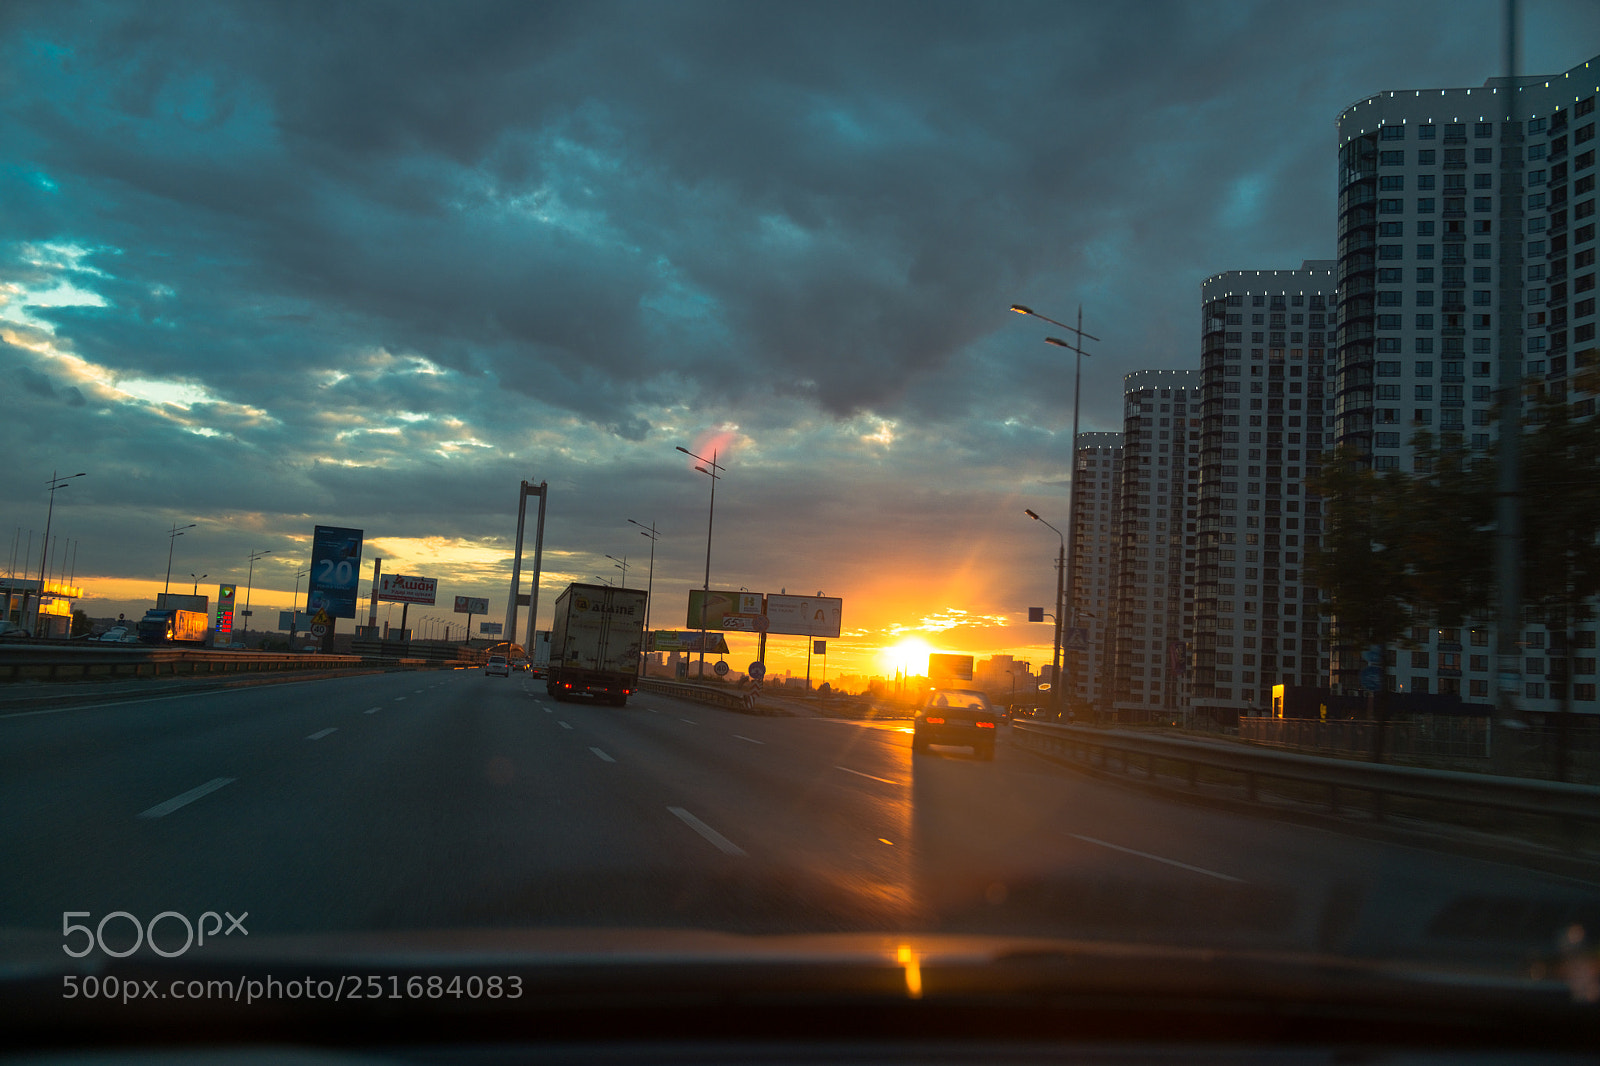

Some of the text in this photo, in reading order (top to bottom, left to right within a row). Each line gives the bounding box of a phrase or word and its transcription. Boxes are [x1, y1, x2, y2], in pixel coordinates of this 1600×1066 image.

[317, 559, 353, 585] 20
[392, 575, 434, 591] Ашан
[313, 626, 324, 634] 40
[716, 664, 726, 673] 40
